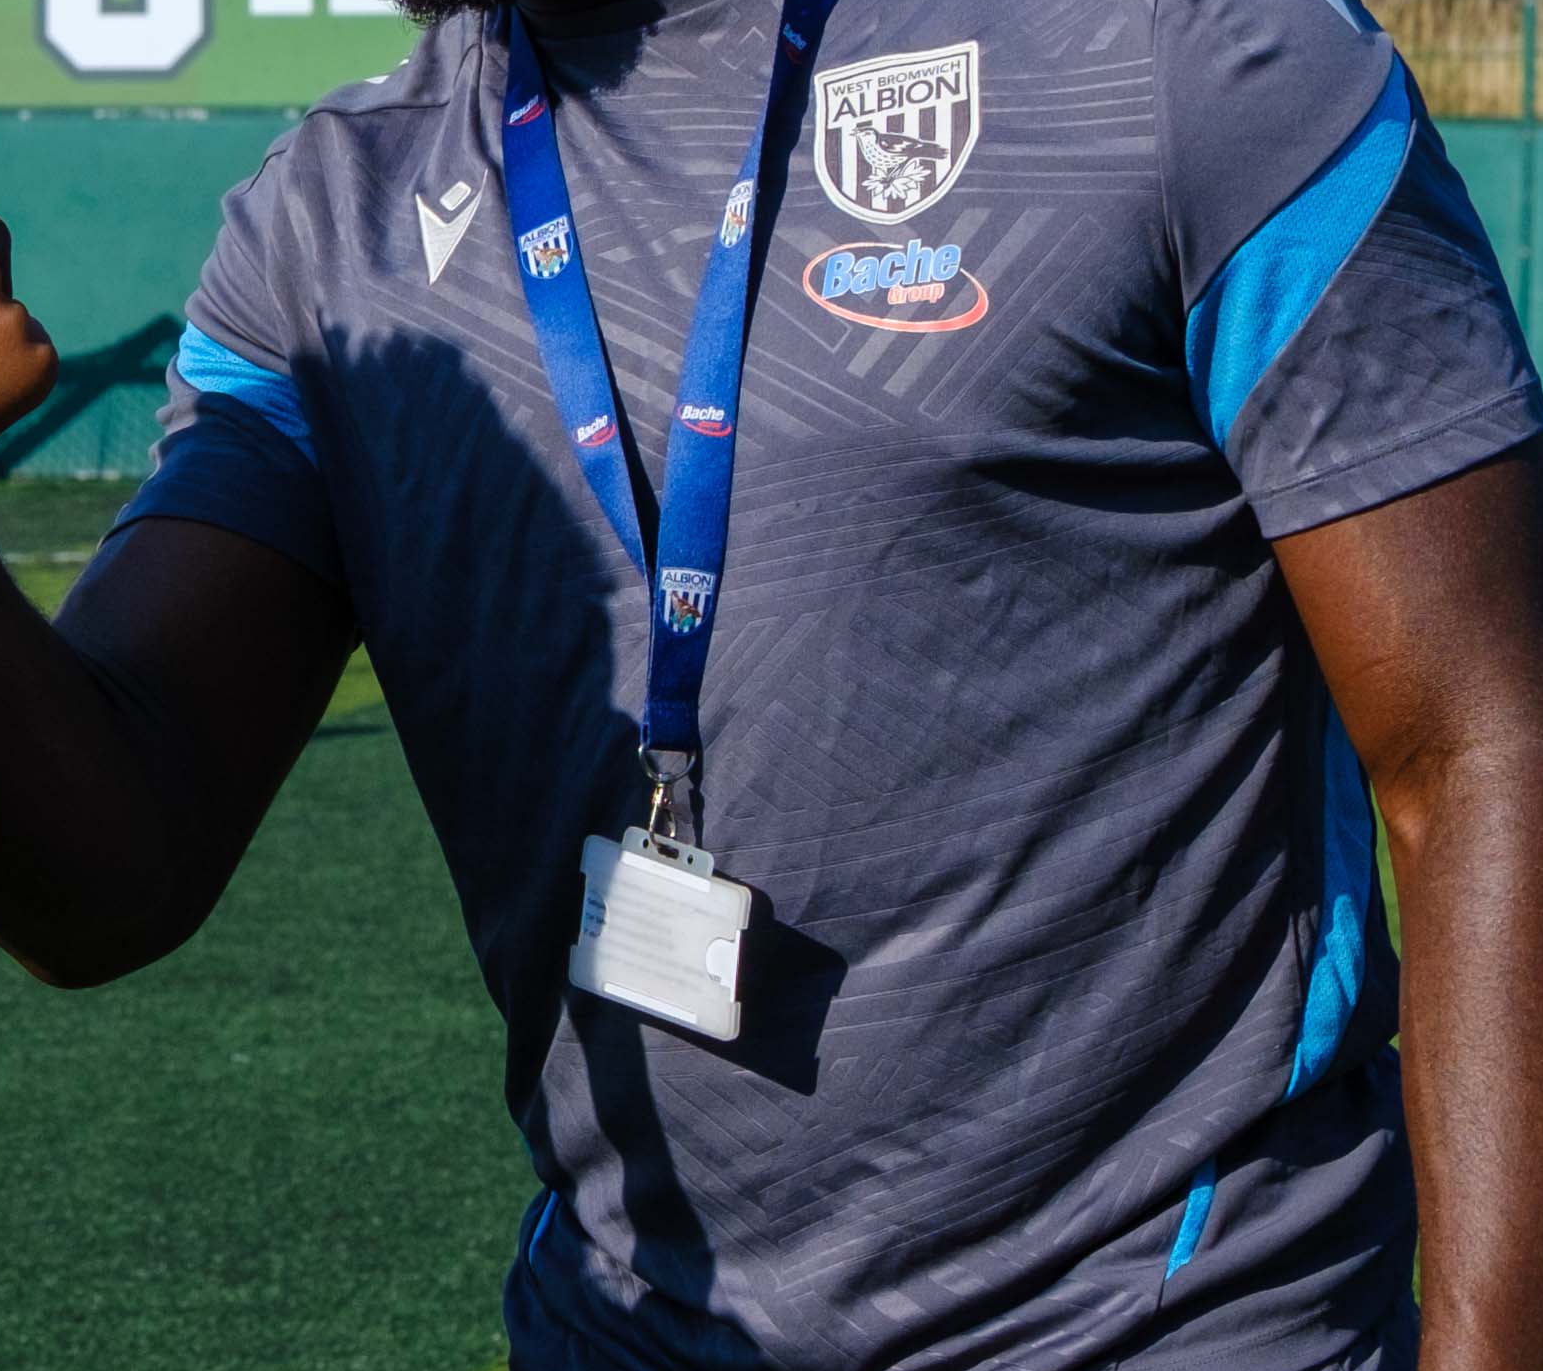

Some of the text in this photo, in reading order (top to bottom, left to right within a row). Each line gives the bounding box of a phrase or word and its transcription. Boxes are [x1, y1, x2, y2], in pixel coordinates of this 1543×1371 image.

[831, 59, 961, 97] WEST BROMWICH
[832, 71, 961, 123] ALBION
[522, 217, 566, 247] ALBION
[821, 238, 962, 300] Bache
[887, 283, 946, 305] Group
[681, 405, 725, 421] Bache
[663, 571, 712, 587] ALBION
